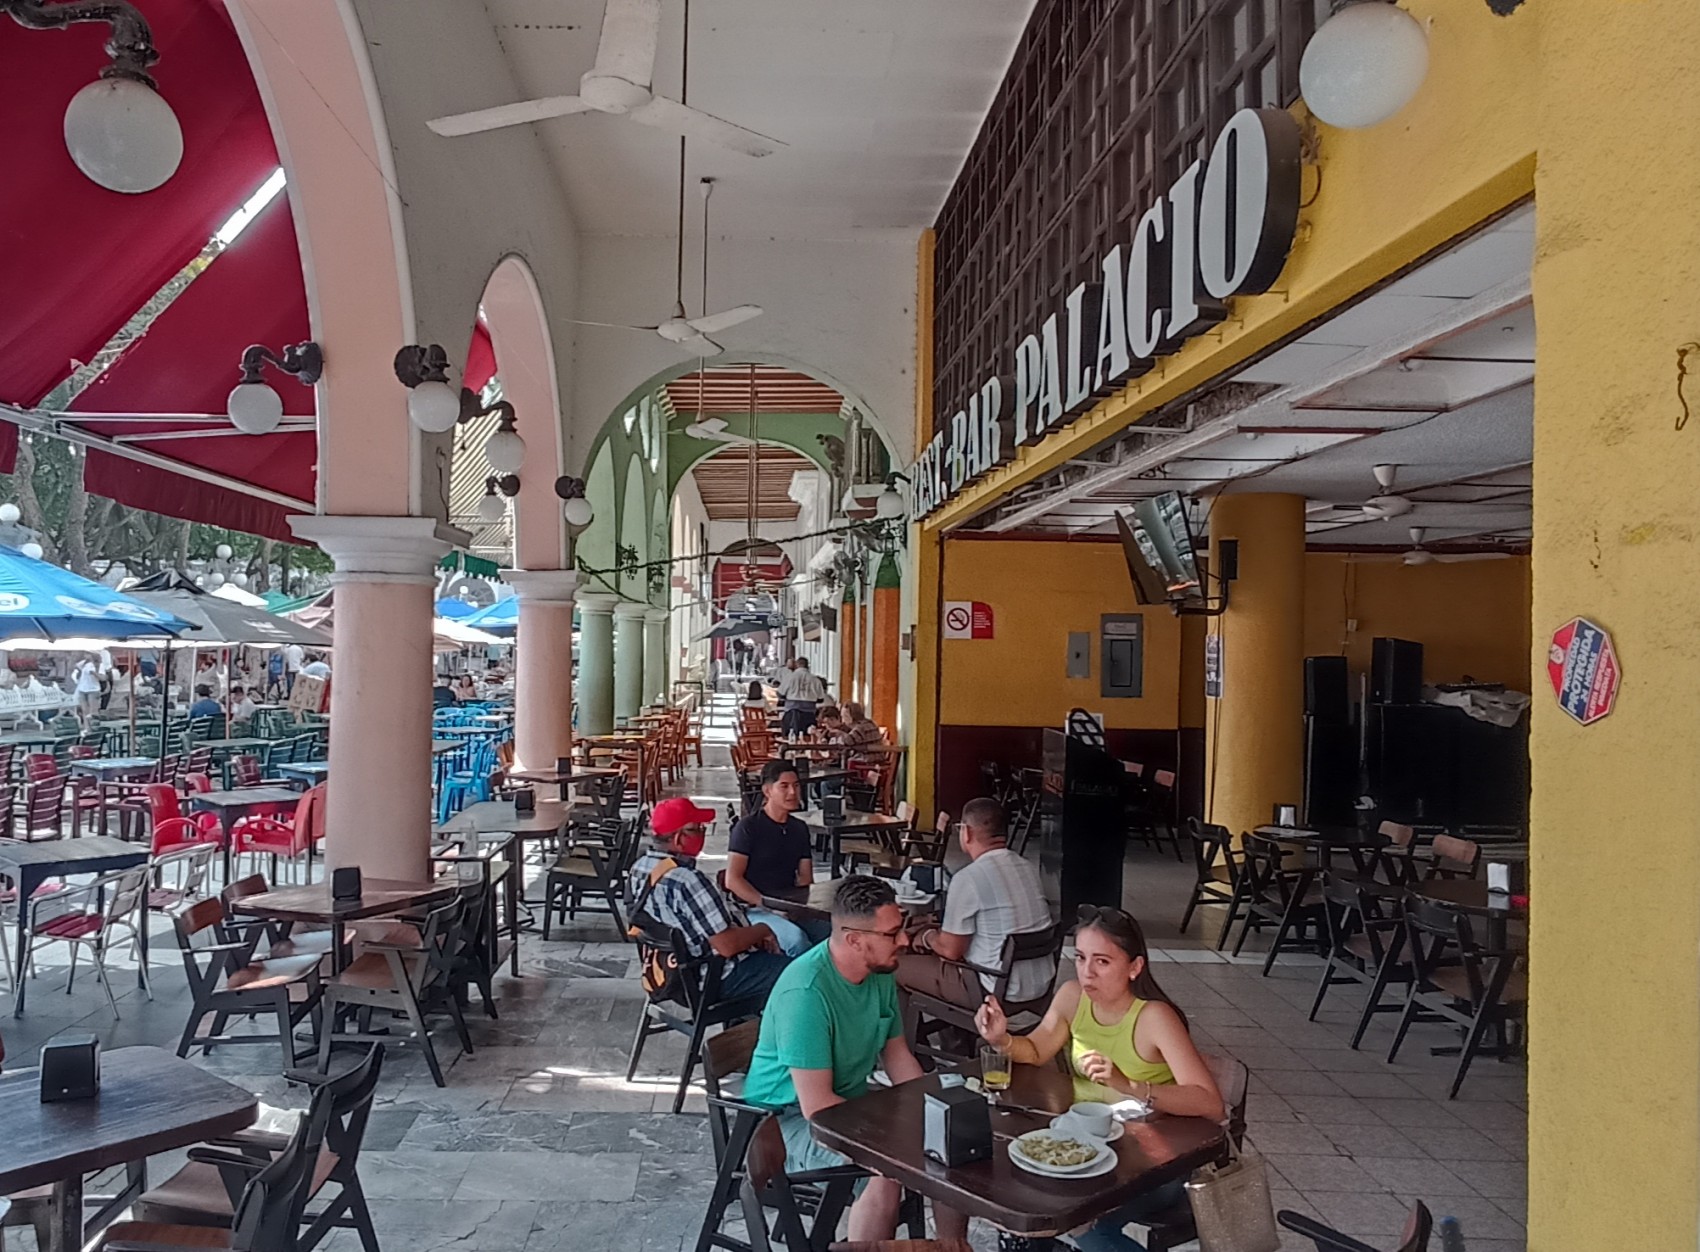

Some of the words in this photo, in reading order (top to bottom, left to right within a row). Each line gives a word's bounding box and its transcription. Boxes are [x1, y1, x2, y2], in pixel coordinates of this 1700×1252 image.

[1015, 108, 1268, 447] PALACIO
[1564, 637, 1580, 691] PROPIEDAD
[1567, 630, 1595, 713] PROTEGIDA
[1584, 651, 1598, 688] HORAS
